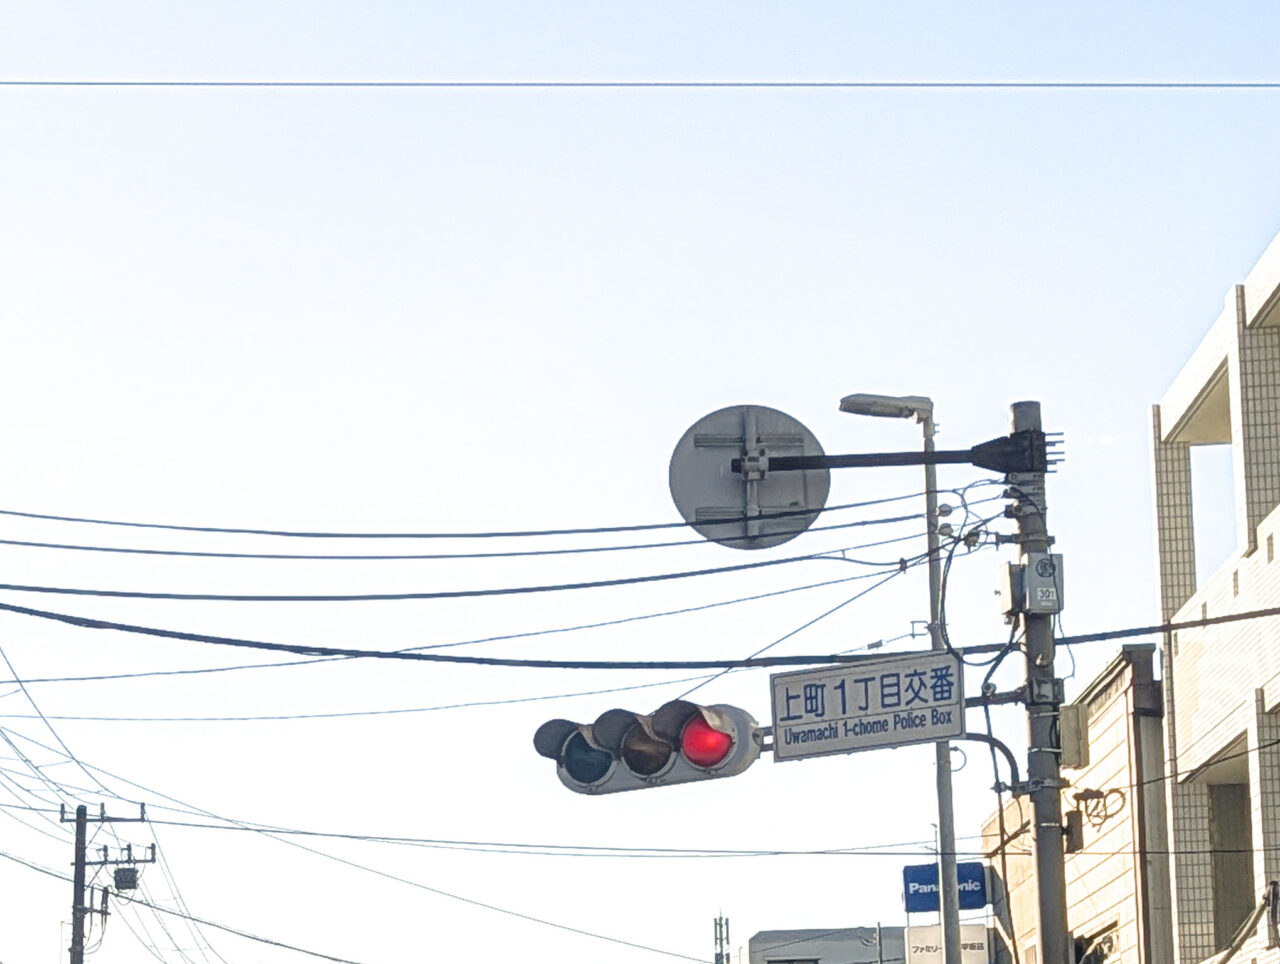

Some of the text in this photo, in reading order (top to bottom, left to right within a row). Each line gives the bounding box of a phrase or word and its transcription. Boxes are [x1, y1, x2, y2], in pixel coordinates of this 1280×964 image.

[780, 665, 955, 722] 上町1丁目交番
[784, 708, 952, 745] Uwamachi 1-chome Police Box
[908, 880, 981, 894] Pannic
